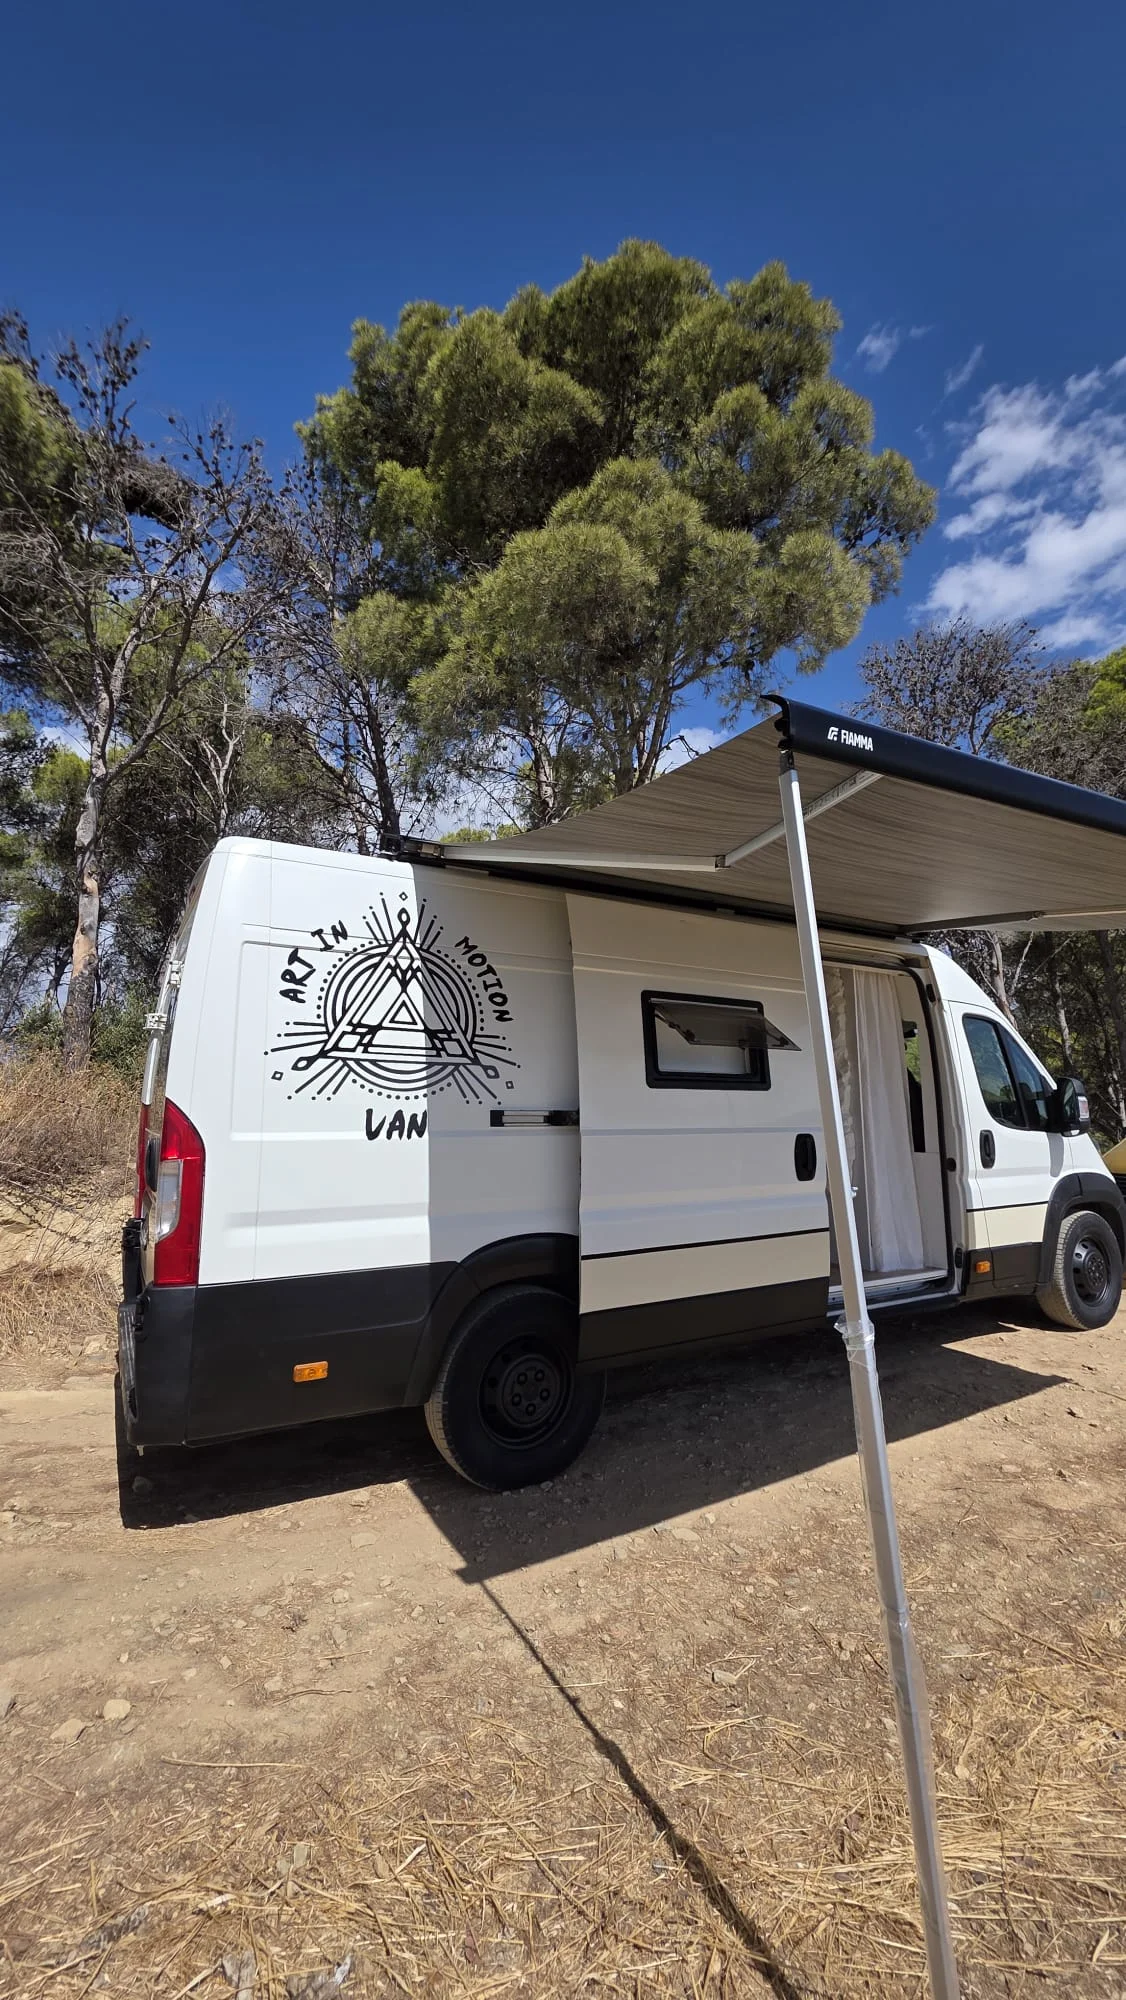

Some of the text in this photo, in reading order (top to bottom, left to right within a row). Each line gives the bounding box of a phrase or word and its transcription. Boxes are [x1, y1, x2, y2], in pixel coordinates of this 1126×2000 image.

[841, 729, 873, 751] FIAMMA
[279, 920, 513, 1023] ART IN MOTION
[365, 1108, 427, 1141] VAN
